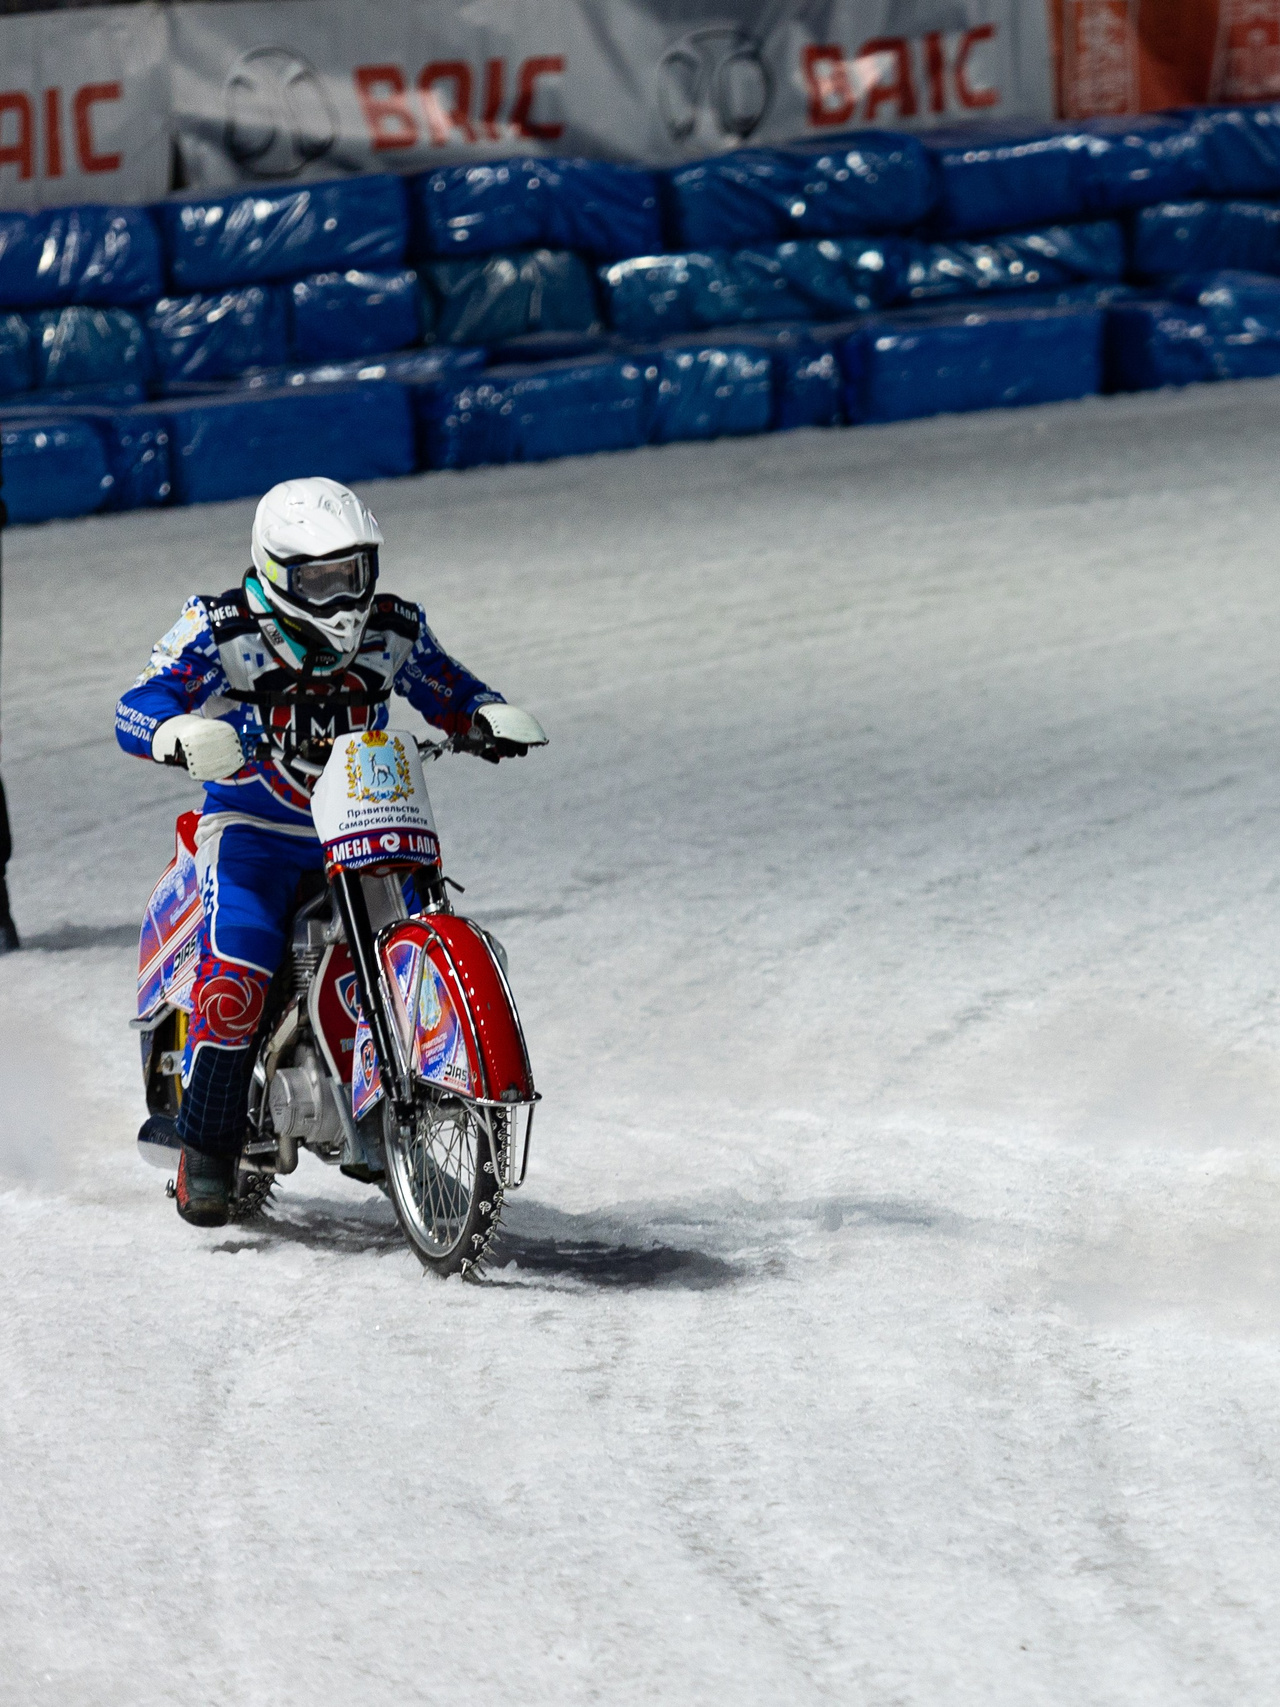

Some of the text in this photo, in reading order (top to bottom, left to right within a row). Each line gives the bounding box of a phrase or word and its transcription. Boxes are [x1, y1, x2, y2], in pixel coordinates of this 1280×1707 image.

[803, 23, 999, 127] BAIC
[353, 54, 566, 152] BAIC
[208, 605, 240, 623] MEGA
[394, 602, 419, 623] LADA
[346, 805, 420, 818] Правительство
[338, 814, 428, 831] Самарской области
[332, 836, 372, 863] MEGA
[408, 833, 438, 856] LADA
